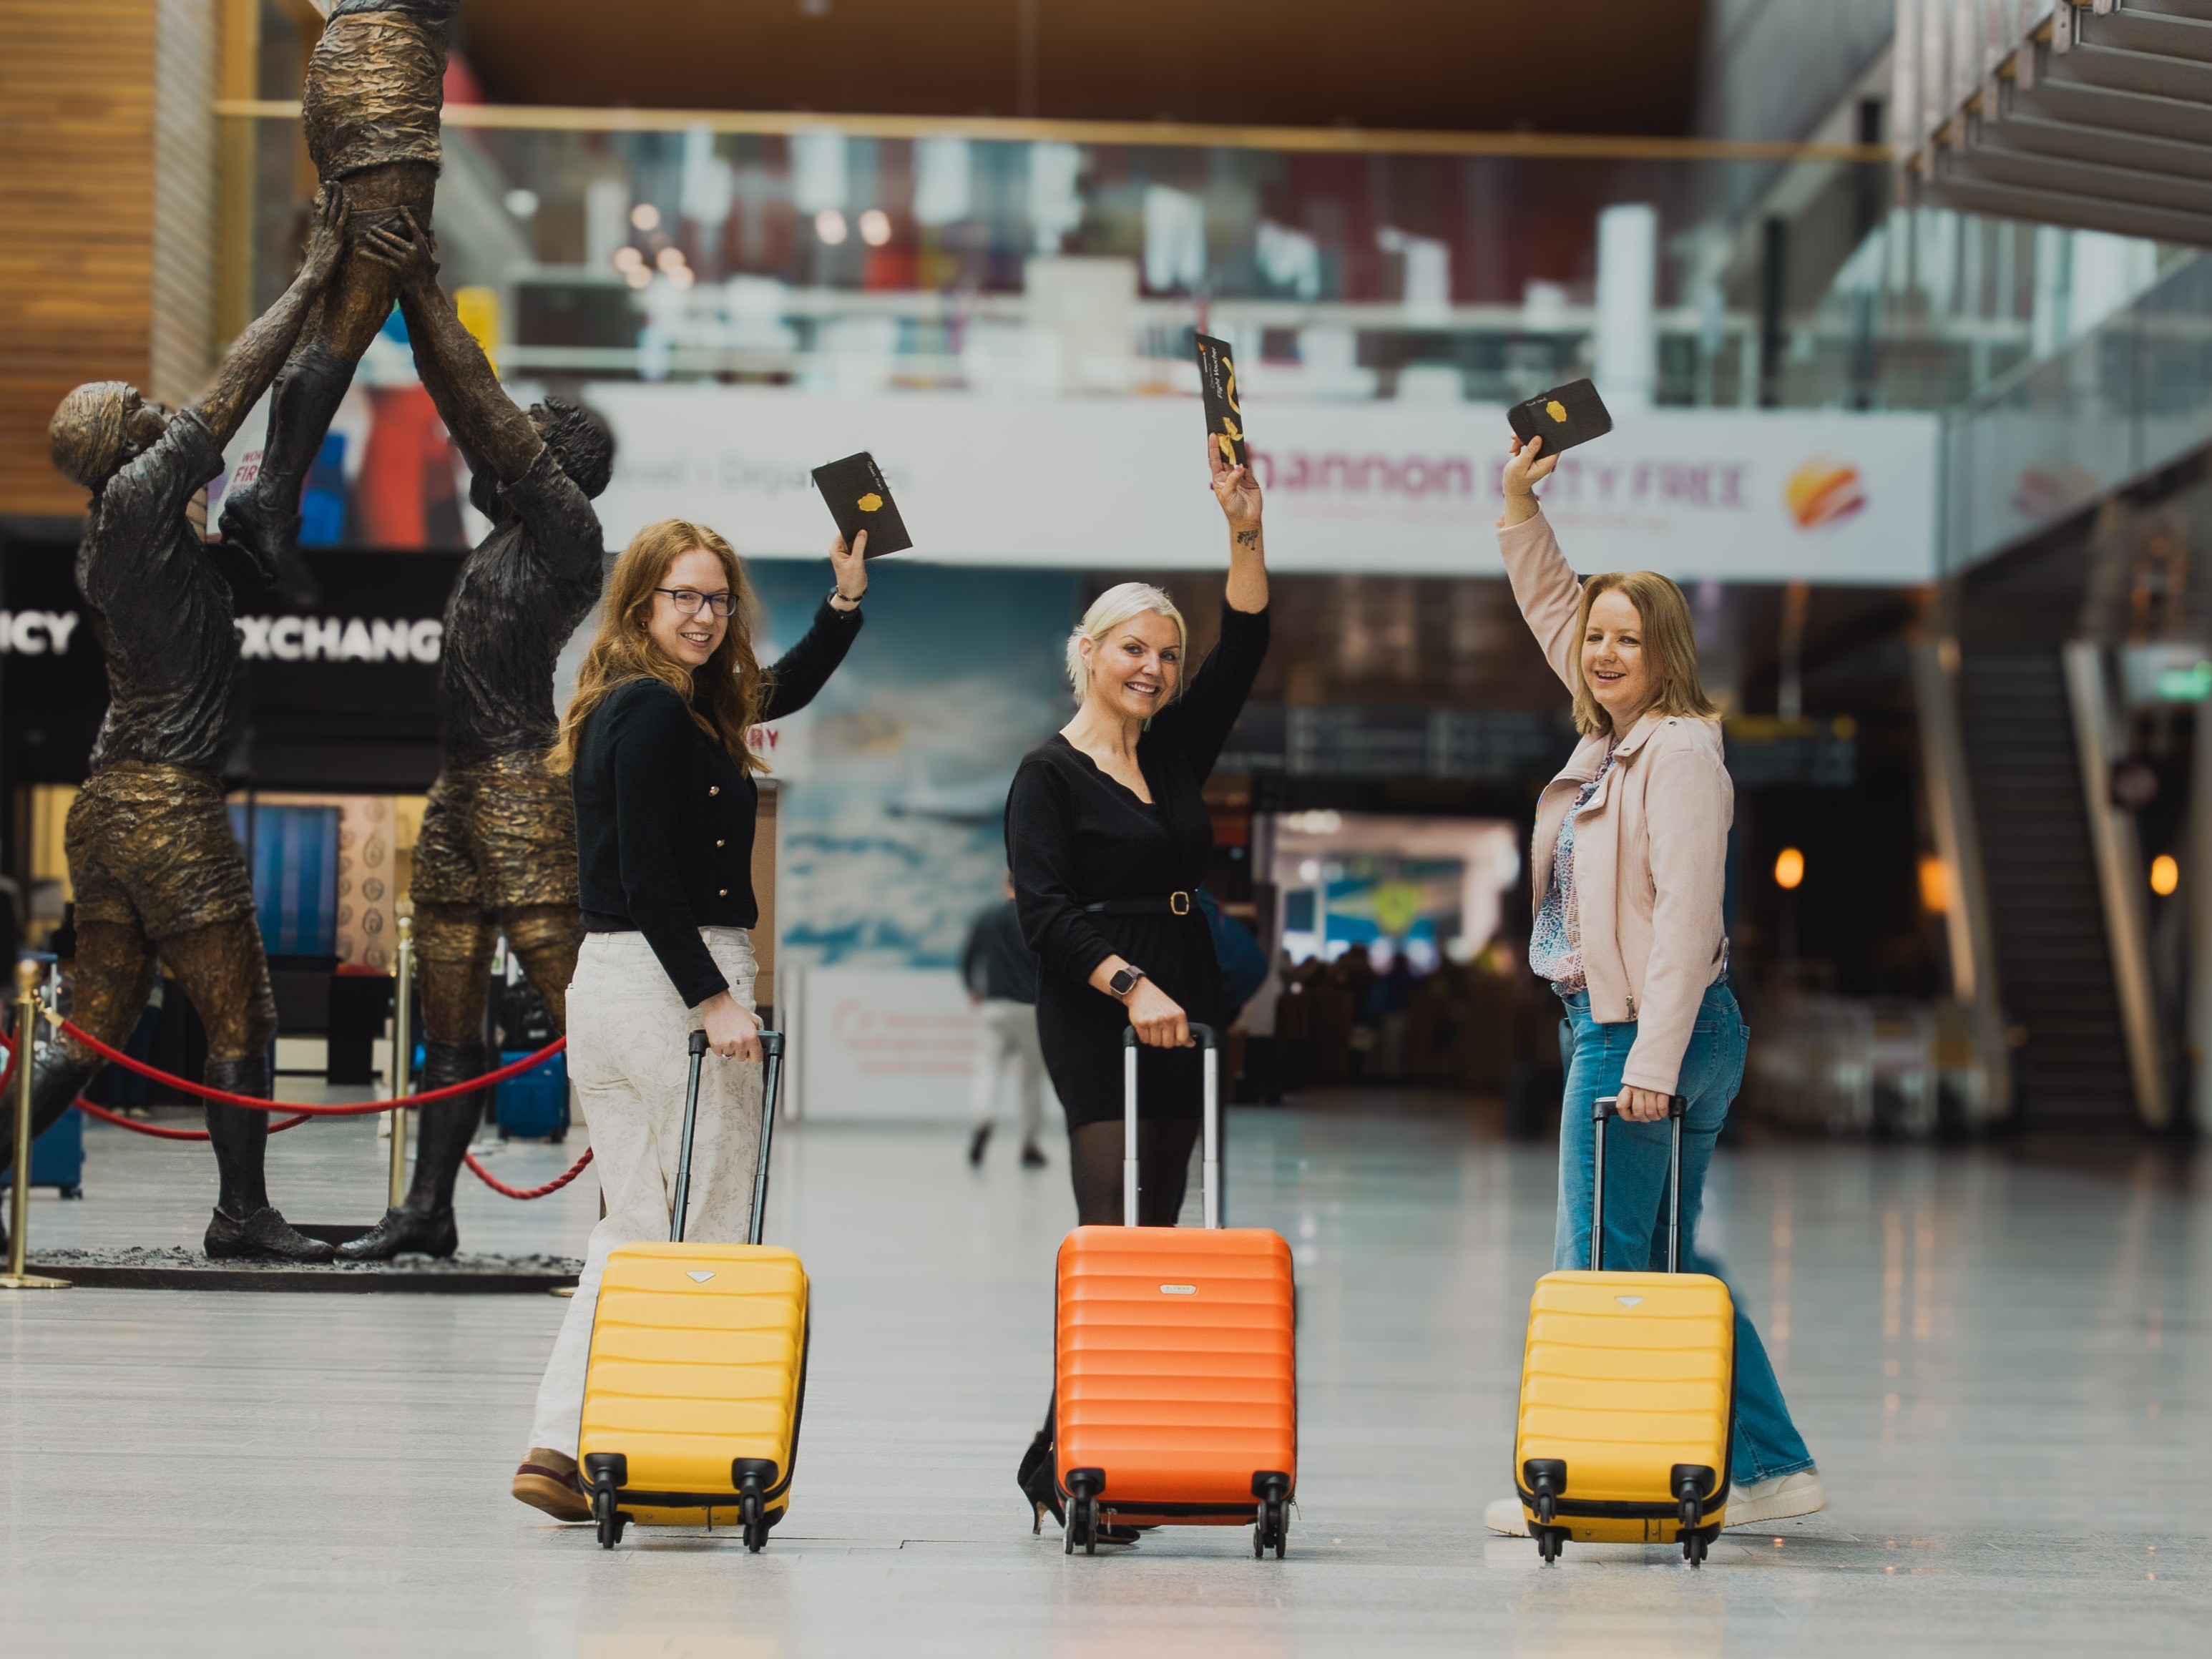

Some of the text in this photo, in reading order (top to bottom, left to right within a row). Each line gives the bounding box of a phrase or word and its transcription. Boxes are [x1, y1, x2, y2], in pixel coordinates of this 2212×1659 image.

[1211, 346, 1220, 376] Voucher
[1215, 377, 1223, 399] Flight
[233, 464, 258, 483] FIR
[1243, 442, 1474, 494] hannon
[1633, 458, 1753, 512] FREE
[233, 615, 444, 663] XCHANG
[749, 728, 779, 749] RY
